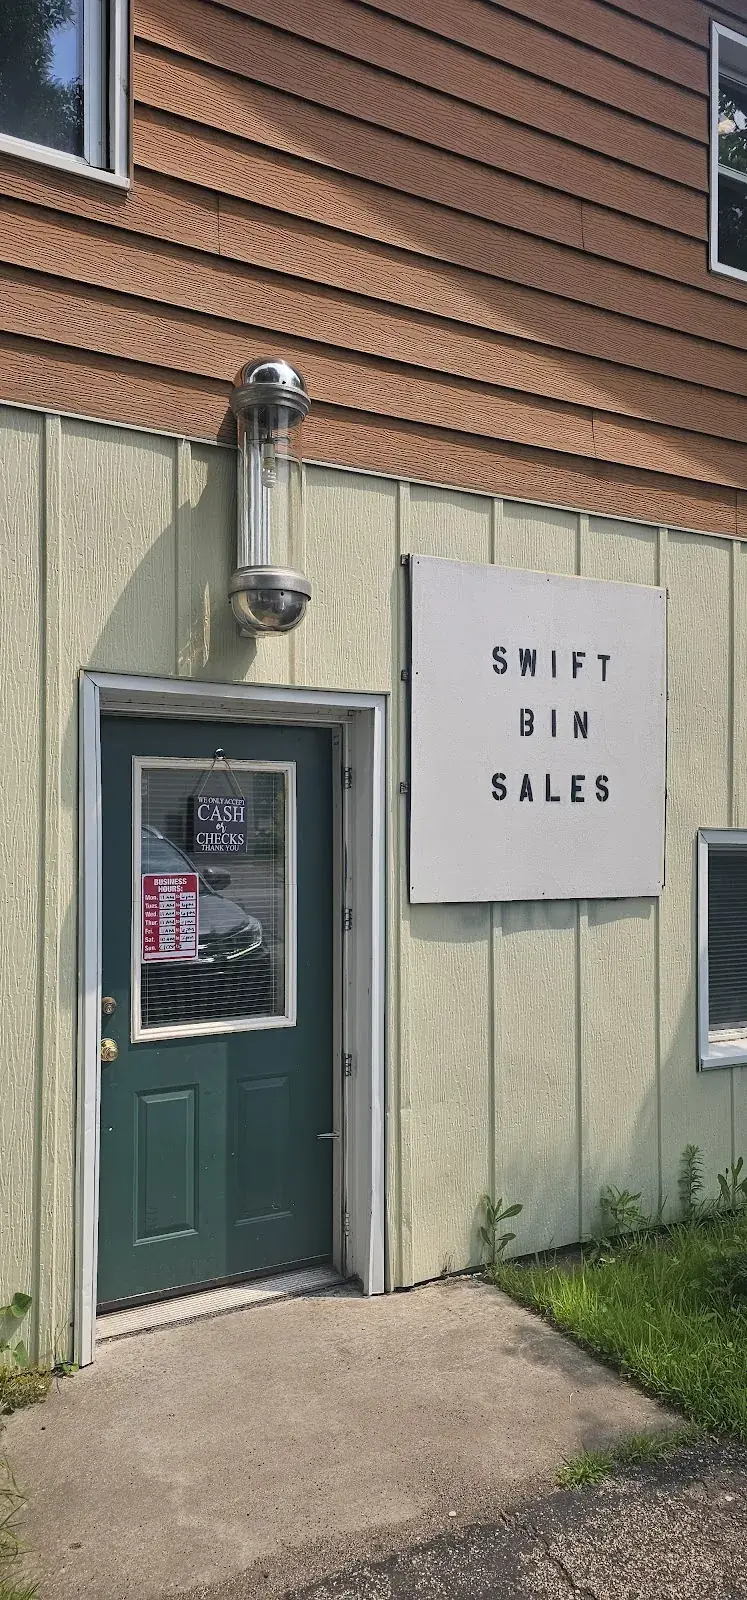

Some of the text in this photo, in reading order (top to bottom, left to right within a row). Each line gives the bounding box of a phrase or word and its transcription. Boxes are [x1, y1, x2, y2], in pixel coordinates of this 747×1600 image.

[492, 646, 611, 682] SWIFT
[519, 708, 588, 739] BIN
[491, 772, 610, 803] SALES
[197, 804, 245, 822] CASH
[196, 832, 245, 845] CHECKS
[215, 822, 227, 833] or
